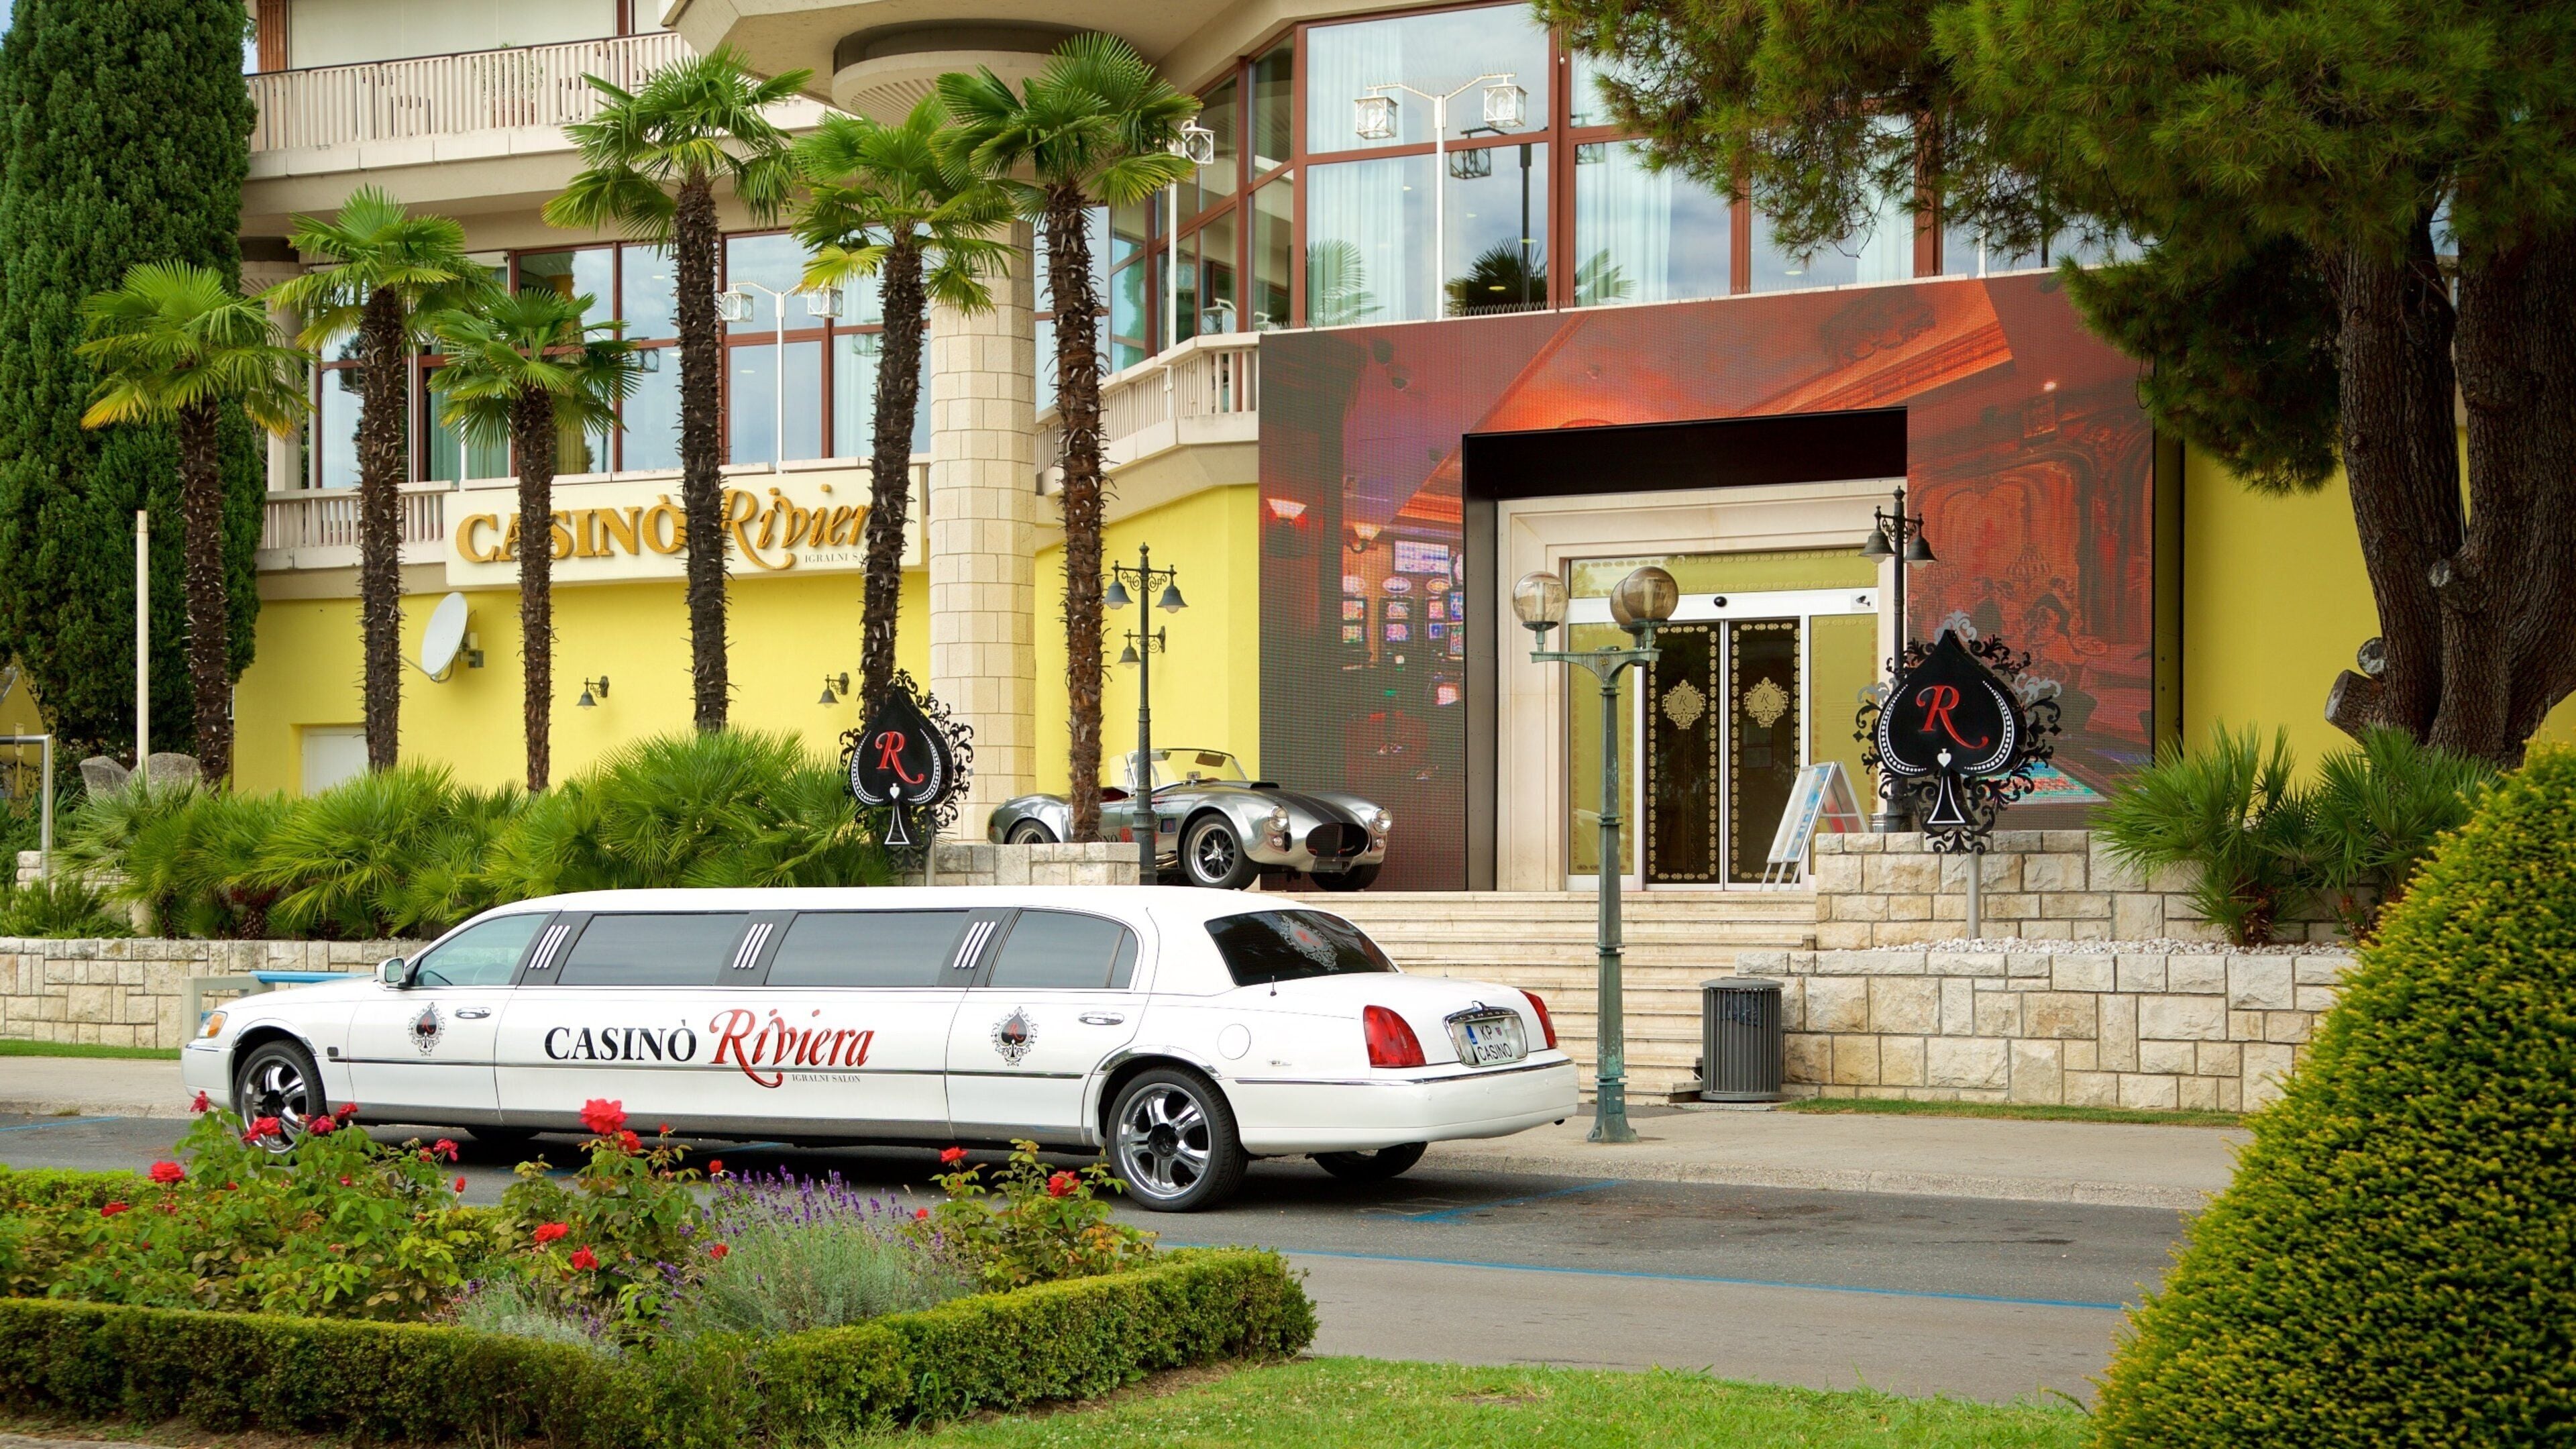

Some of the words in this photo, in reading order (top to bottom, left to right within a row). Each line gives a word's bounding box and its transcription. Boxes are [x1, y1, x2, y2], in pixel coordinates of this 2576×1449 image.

[719, 484, 872, 570] Rivier
[805, 553, 848, 564] IGRALNI
[1916, 685, 1989, 749] R
[875, 731, 925, 784] R
[544, 1019, 697, 1062] CASINÒ
[708, 1008, 875, 1088] Riviera
[1479, 1025, 1493, 1041] KP
[1477, 1042, 1513, 1061] CASINO
[792, 1074, 829, 1082] IGRALNI
[832, 1075, 861, 1083] SALON
